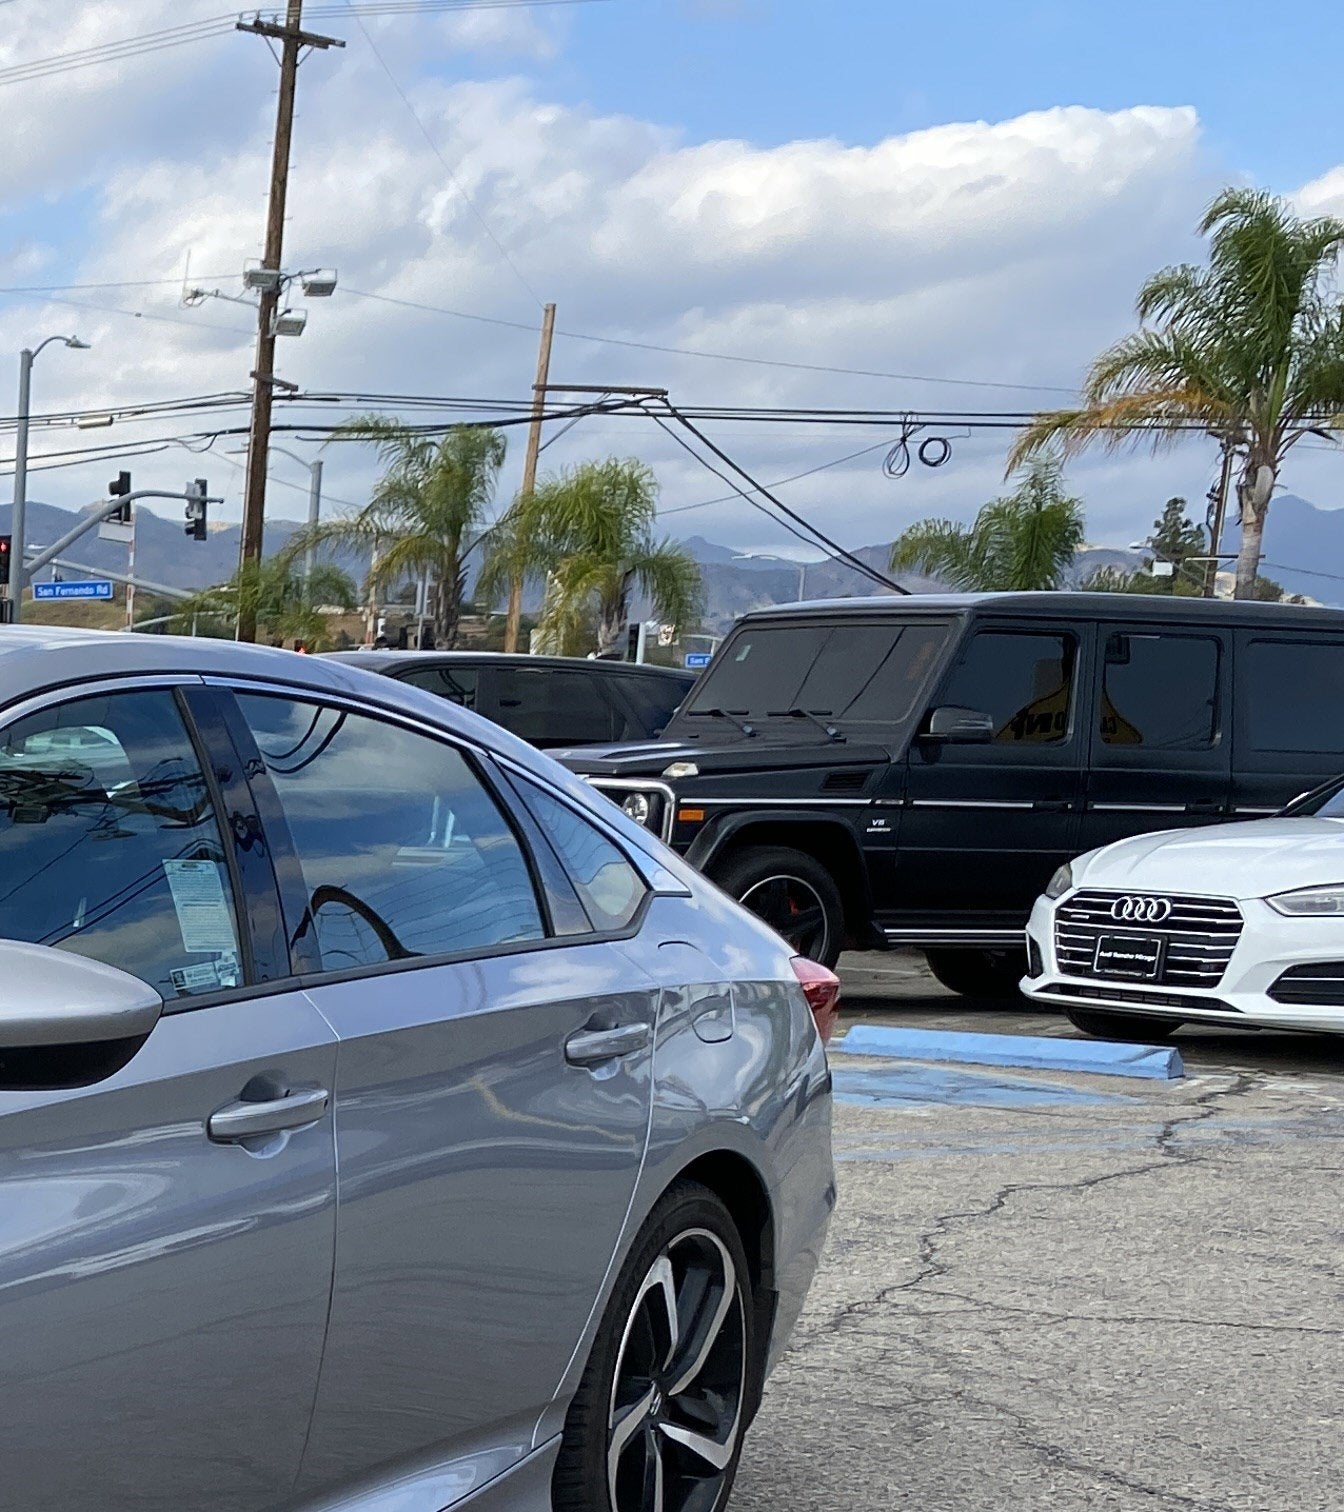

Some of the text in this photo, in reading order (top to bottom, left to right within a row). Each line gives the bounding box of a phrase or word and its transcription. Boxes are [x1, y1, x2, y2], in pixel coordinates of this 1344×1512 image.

[37, 585, 108, 596] San Fernando Rd
